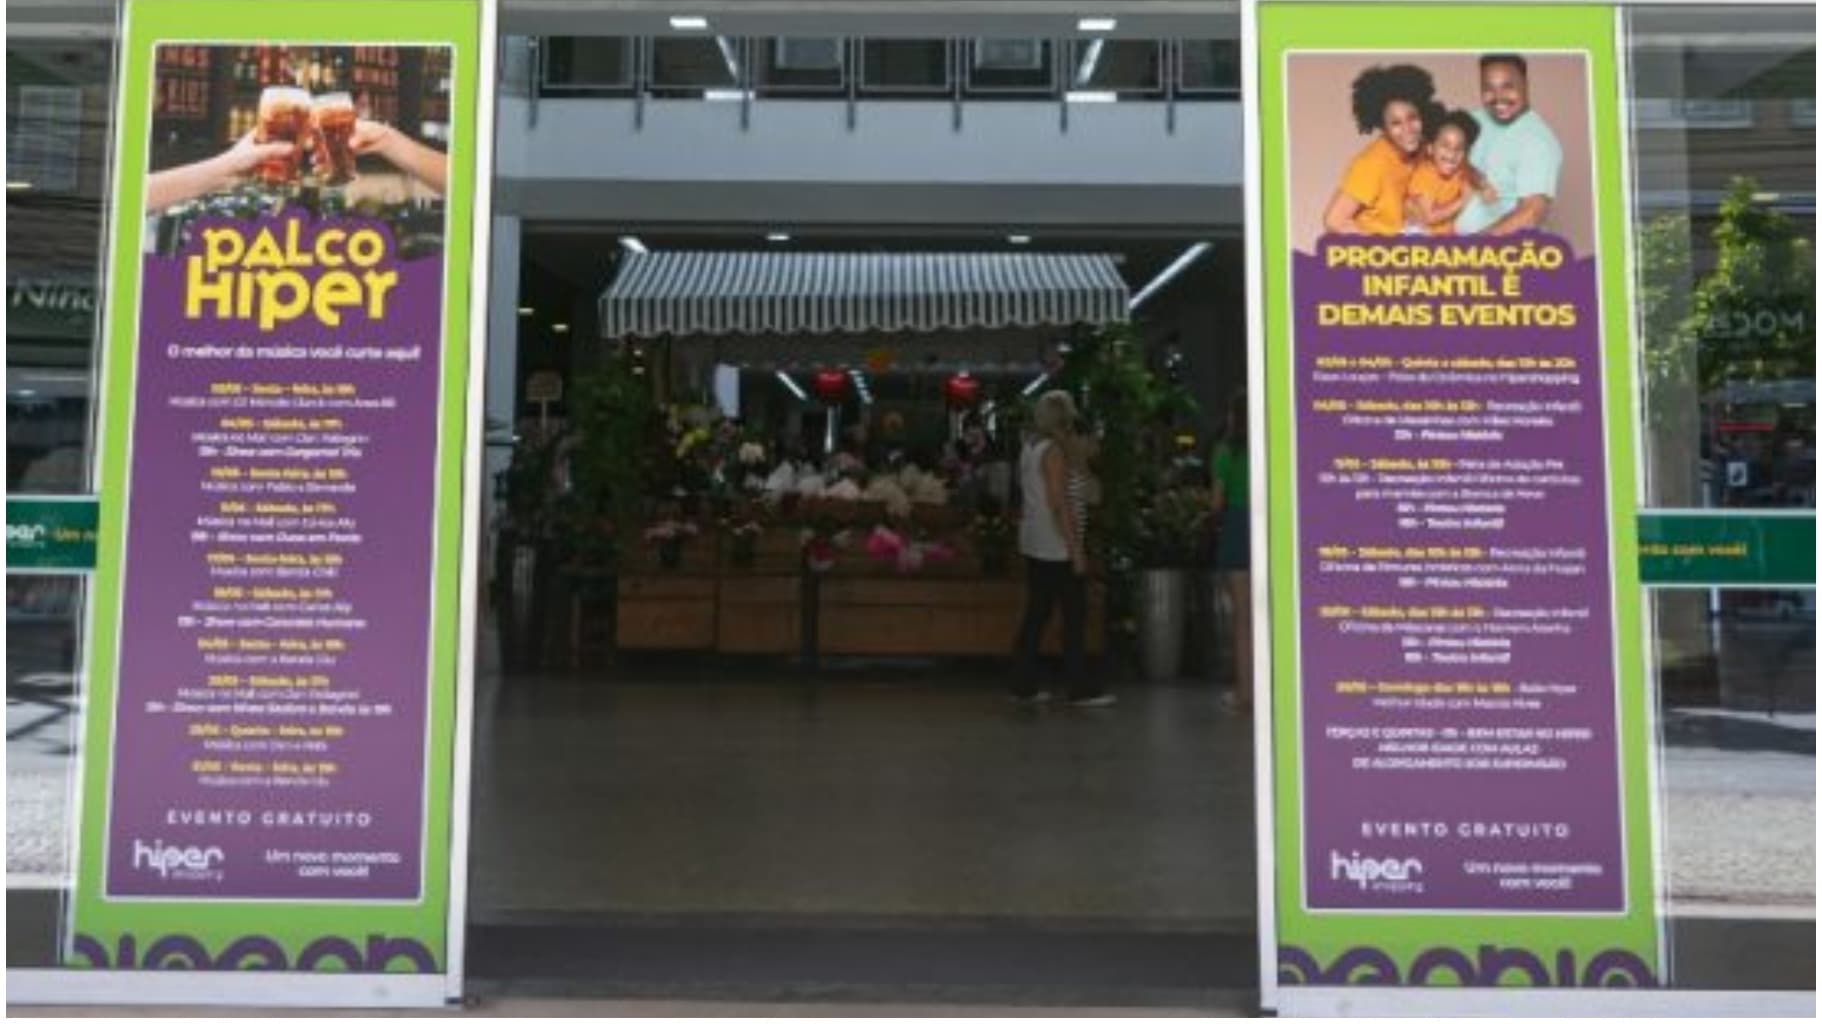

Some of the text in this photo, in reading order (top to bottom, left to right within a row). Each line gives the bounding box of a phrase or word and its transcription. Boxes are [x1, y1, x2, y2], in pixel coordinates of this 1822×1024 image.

[203, 218, 384, 273] PALCO
[1327, 241, 1563, 273] PROGRAMAÇÃO
[186, 255, 397, 330] Hiper
[1363, 275, 1496, 296] INFANTIL
[1319, 304, 1576, 326] DEMAIS EVENTOS
[167, 343, 180, 359] O
[182, 344, 232, 359] melhor
[167, 810, 372, 827] EVENTO GRATUITO
[1361, 822, 1569, 839] EVENTO GRATUITO
[134, 839, 224, 878] hiper
[1331, 850, 1423, 890] hiper
